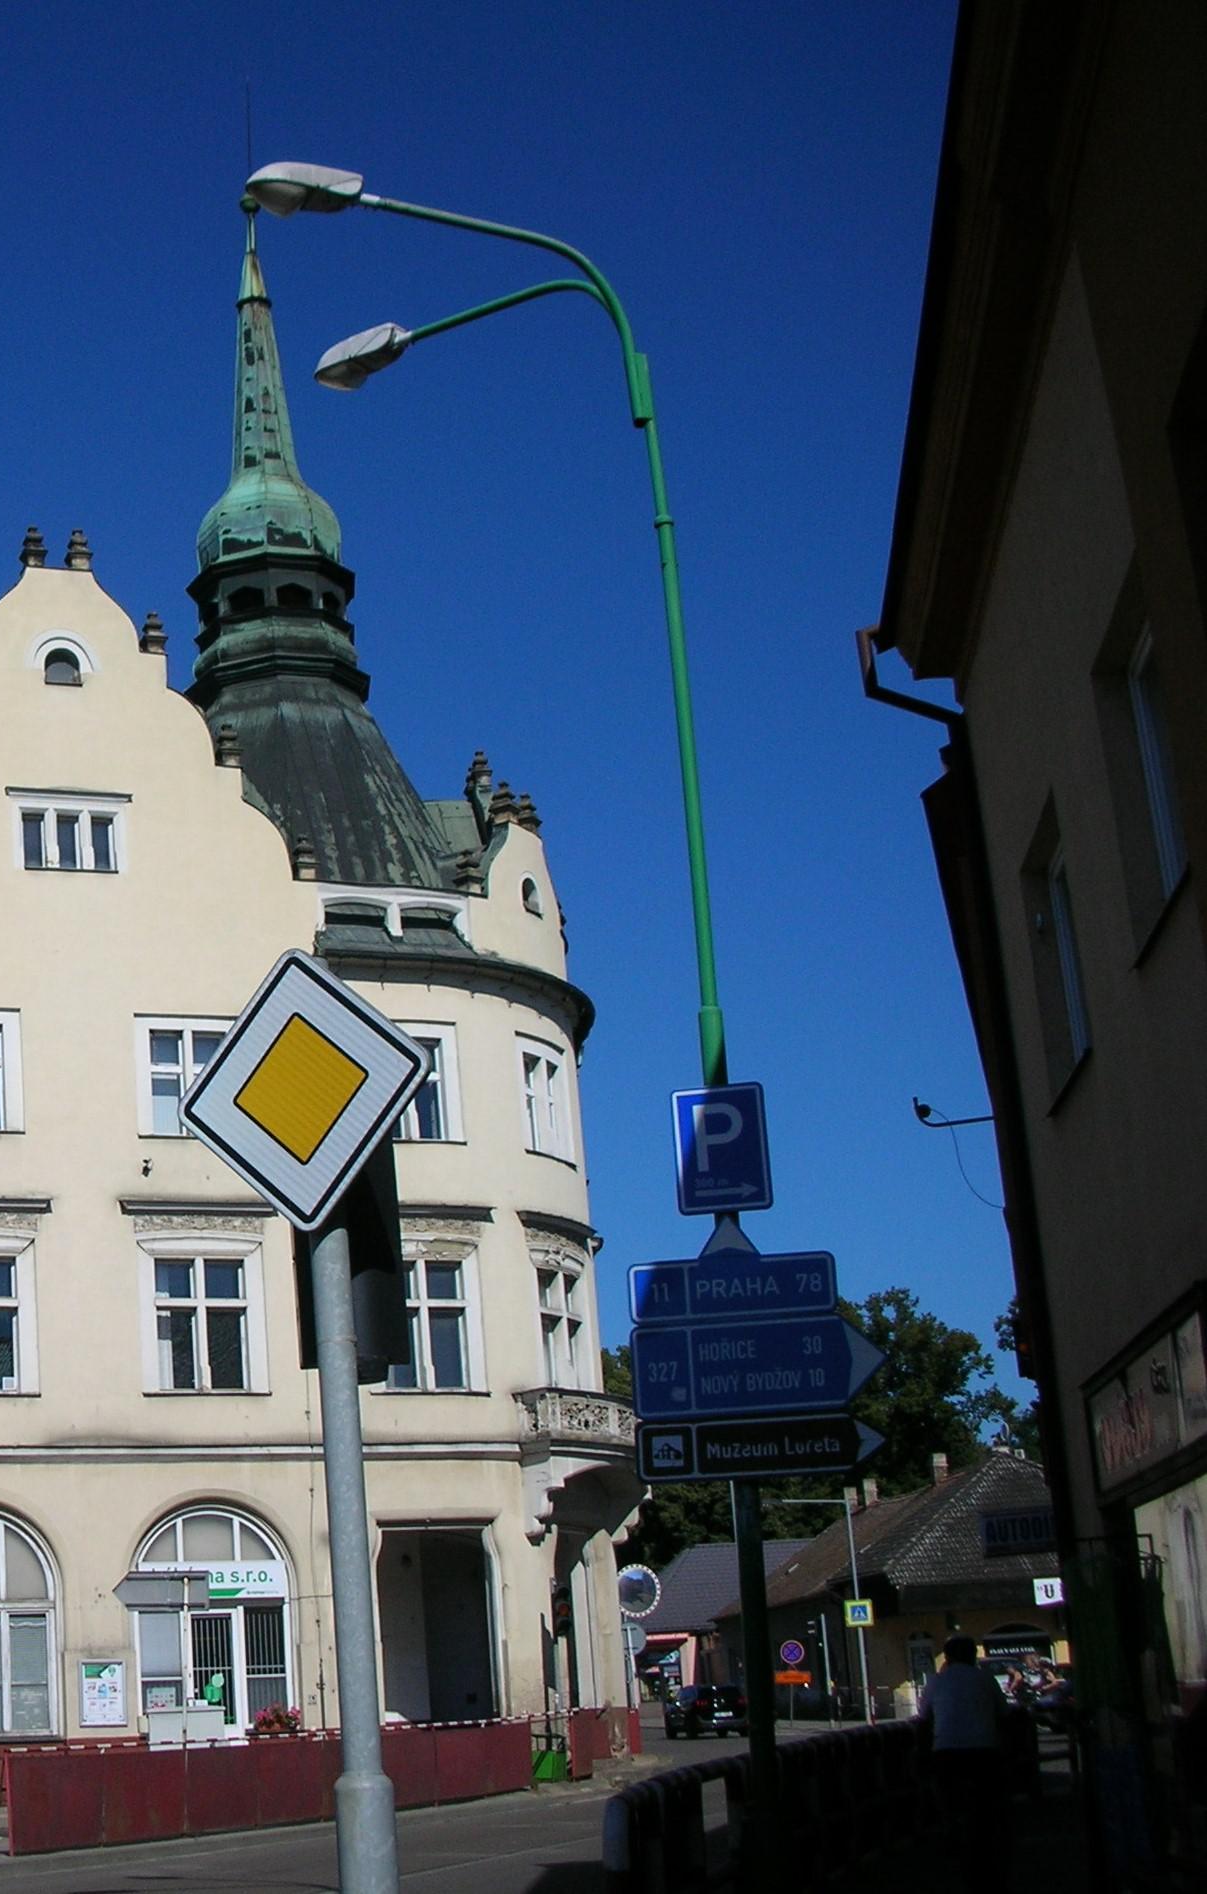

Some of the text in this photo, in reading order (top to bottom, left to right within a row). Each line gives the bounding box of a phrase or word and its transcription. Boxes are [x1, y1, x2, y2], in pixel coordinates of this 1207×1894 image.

[692, 1102, 744, 1173] P
[650, 1272, 823, 1304] 11 PRAHA 78
[698, 1335, 823, 1362] HOŘICE 30
[648, 1360, 678, 1384] 327
[700, 1366, 826, 1396] NOVÝ BYDŽOV 10
[706, 1442, 779, 1460] Muzeum
[230, 1570, 274, 1583] s.r.o.
